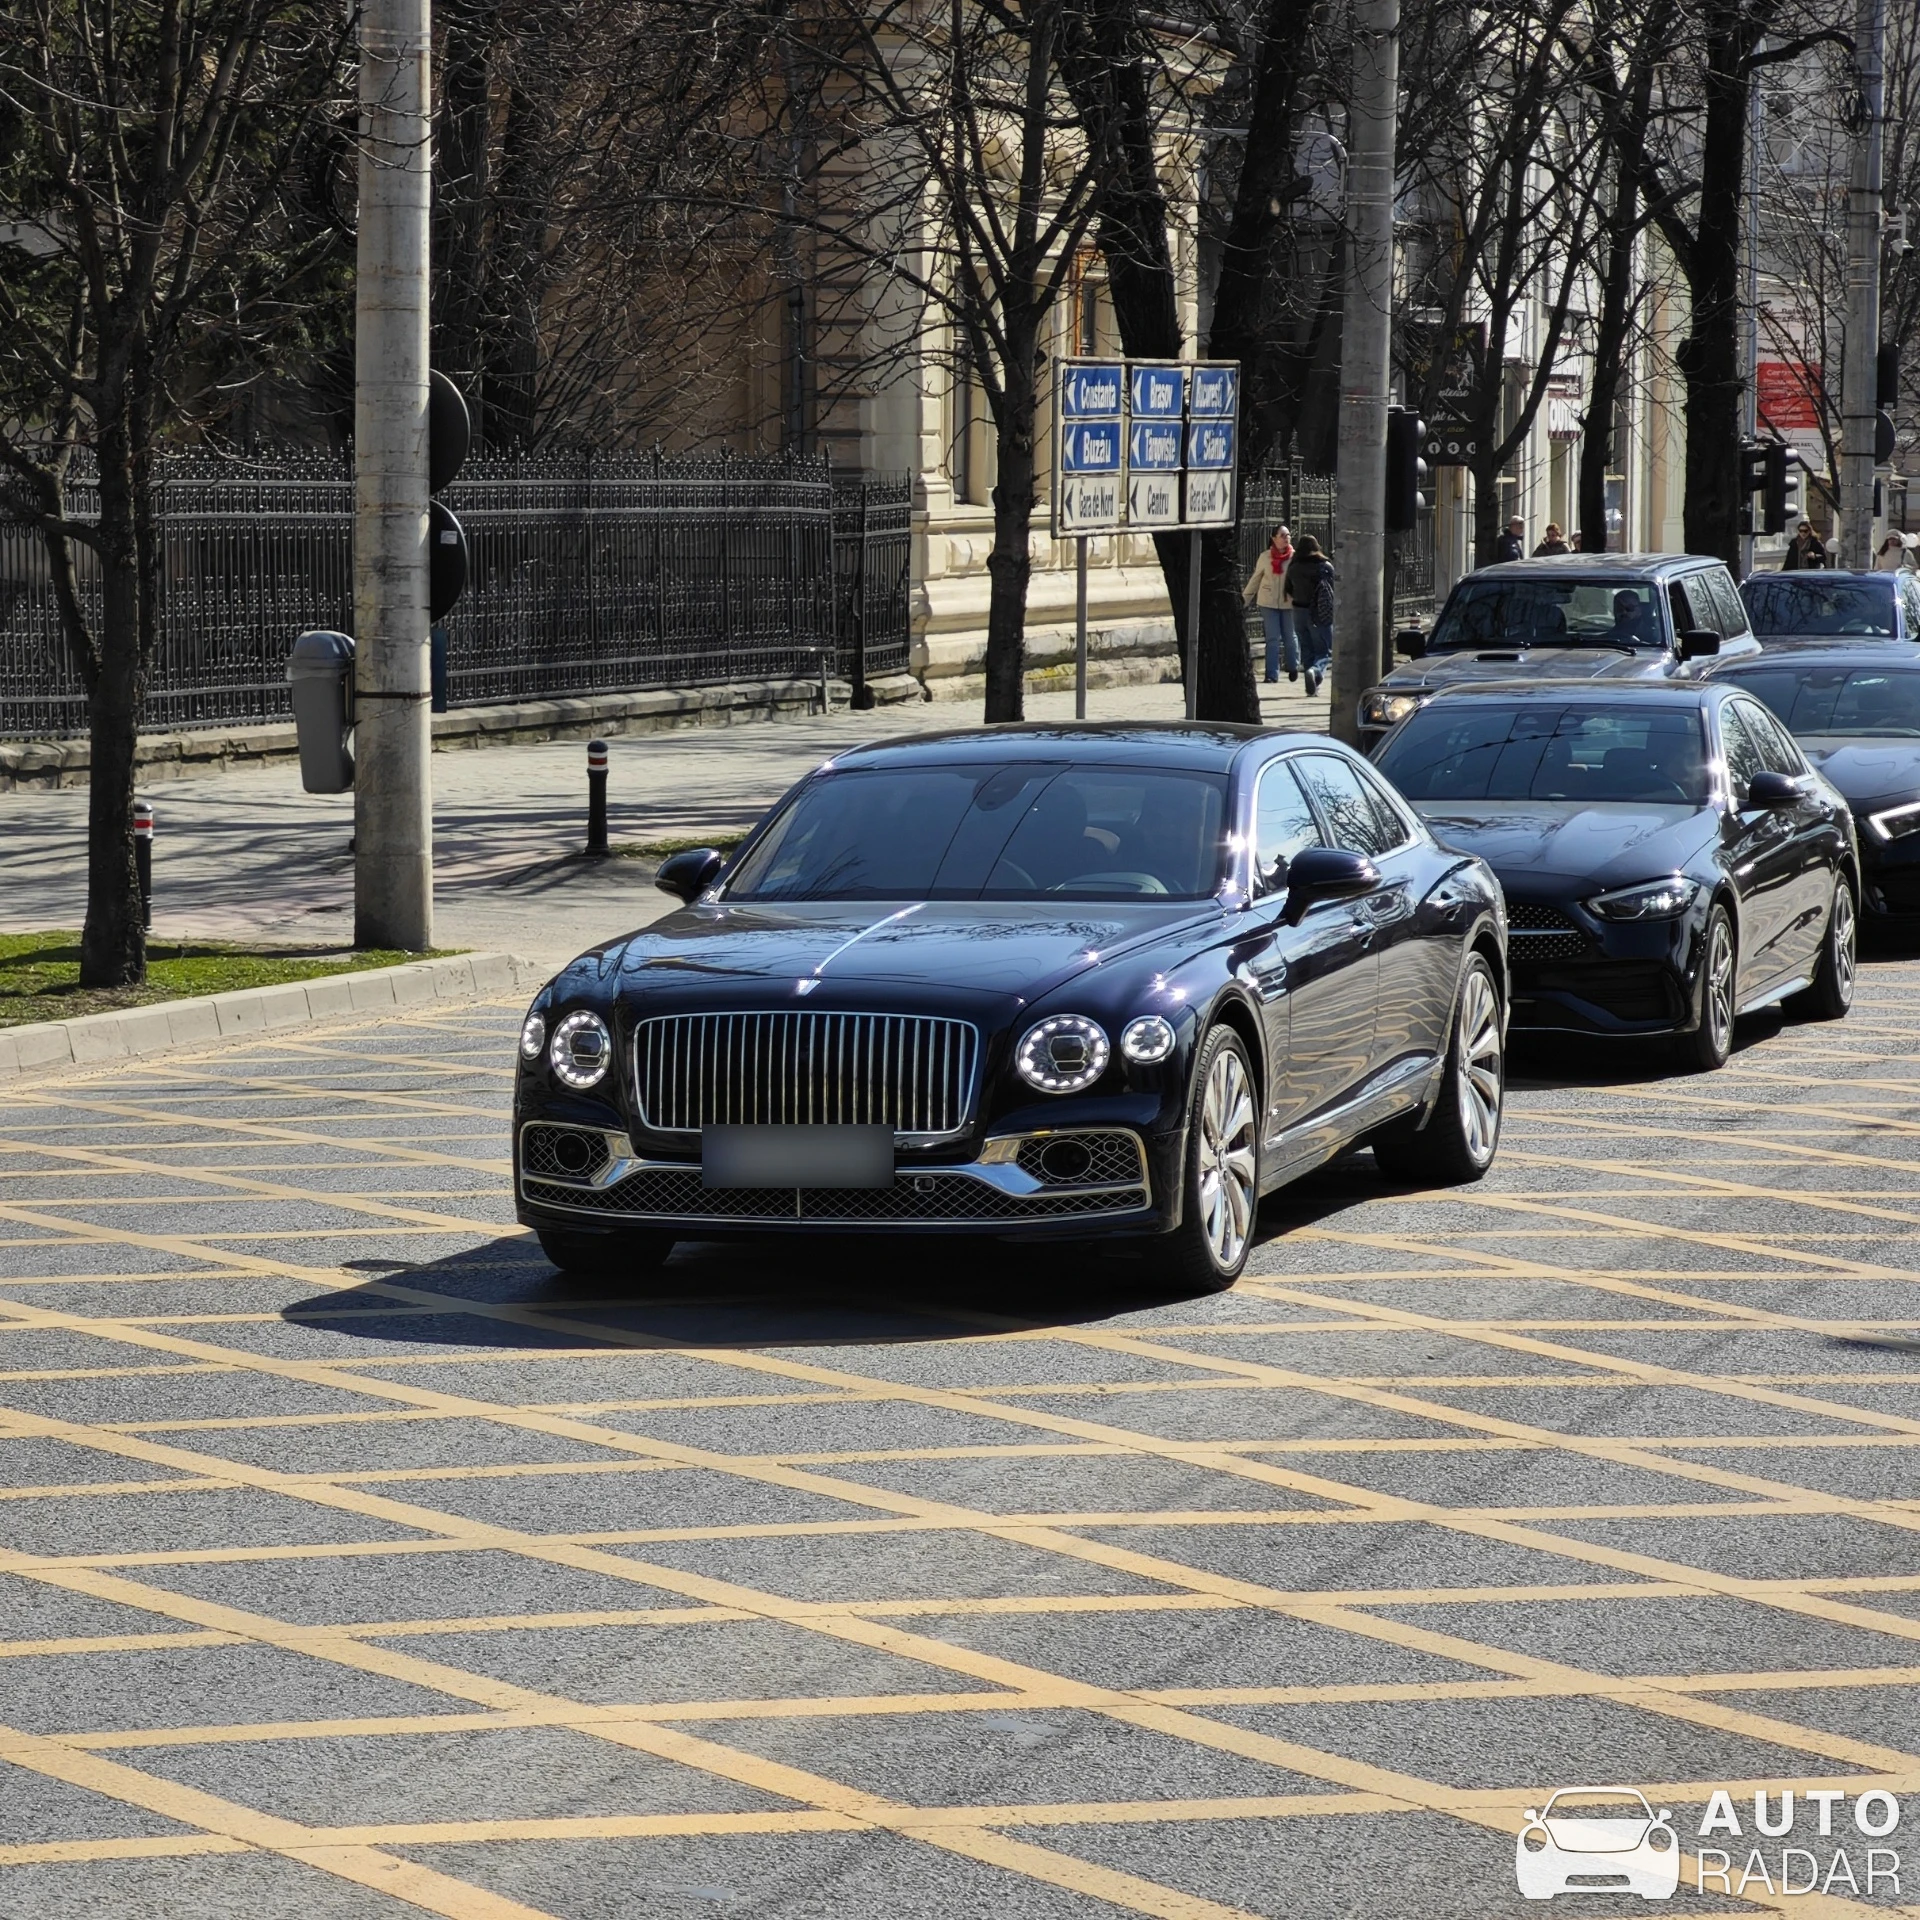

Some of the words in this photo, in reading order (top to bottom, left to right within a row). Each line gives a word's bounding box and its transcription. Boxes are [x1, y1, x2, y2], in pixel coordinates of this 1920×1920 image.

[1150, 375, 1174, 415] Brașov
[1083, 429, 1112, 464] Buzău
[1079, 486, 1092, 518] Gara
[1092, 486, 1100, 518] de
[1100, 485, 1114, 518] Nord
[1147, 484, 1170, 515] Centru
